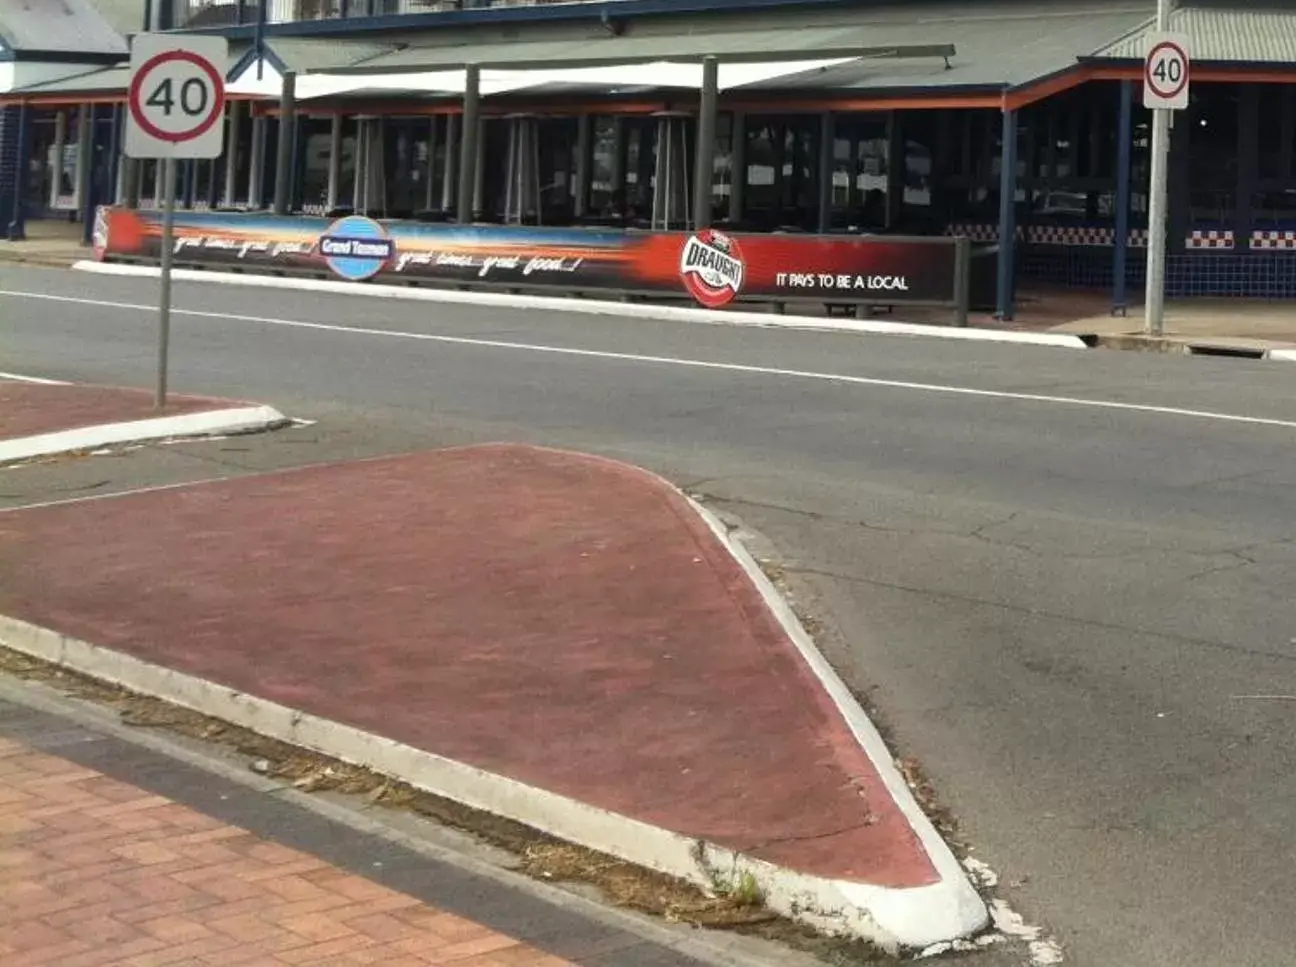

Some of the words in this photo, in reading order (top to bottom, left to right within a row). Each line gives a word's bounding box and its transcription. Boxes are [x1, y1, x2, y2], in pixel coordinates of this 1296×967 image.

[1153, 58, 1181, 82] 40
[145, 77, 208, 116] 40
[322, 238, 352, 254] Grand
[776, 272, 787, 287] IT
[788, 273, 814, 287] PAYS
[817, 273, 834, 288] TO
[837, 274, 851, 289] BE
[853, 275, 865, 289] A
[867, 276, 908, 290] LOCAL
